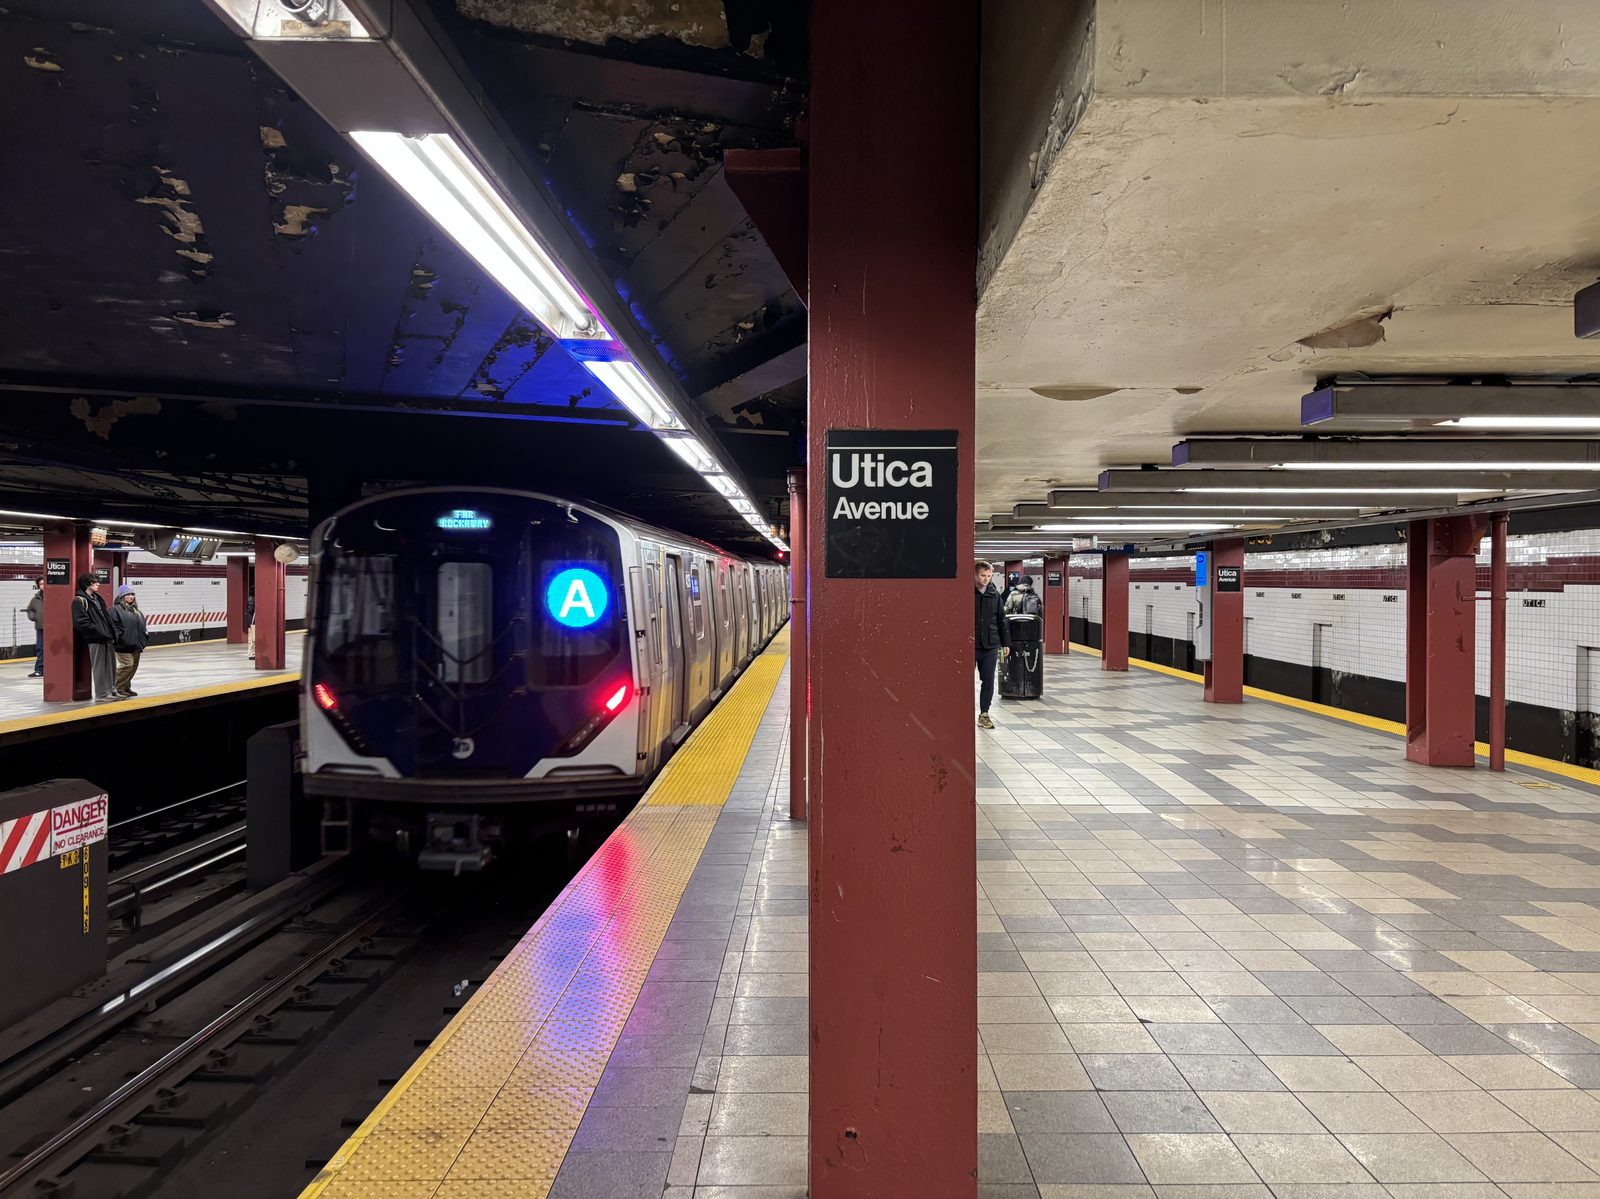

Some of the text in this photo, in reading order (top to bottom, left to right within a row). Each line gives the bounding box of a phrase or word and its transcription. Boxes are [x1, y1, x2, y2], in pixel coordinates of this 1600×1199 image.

[832, 453, 933, 488] Utica
[454, 510, 474, 519] FAR
[832, 496, 930, 520] Avenue
[439, 518, 490, 529] ROCKAWAY
[47, 562, 66, 570] Utica
[559, 579, 596, 618] A
[1522, 599, 1546, 608] UTICA
[53, 799, 107, 831] DANGER
[67, 827, 104, 846] CLEARANCE
[55, 839, 66, 850] NO
